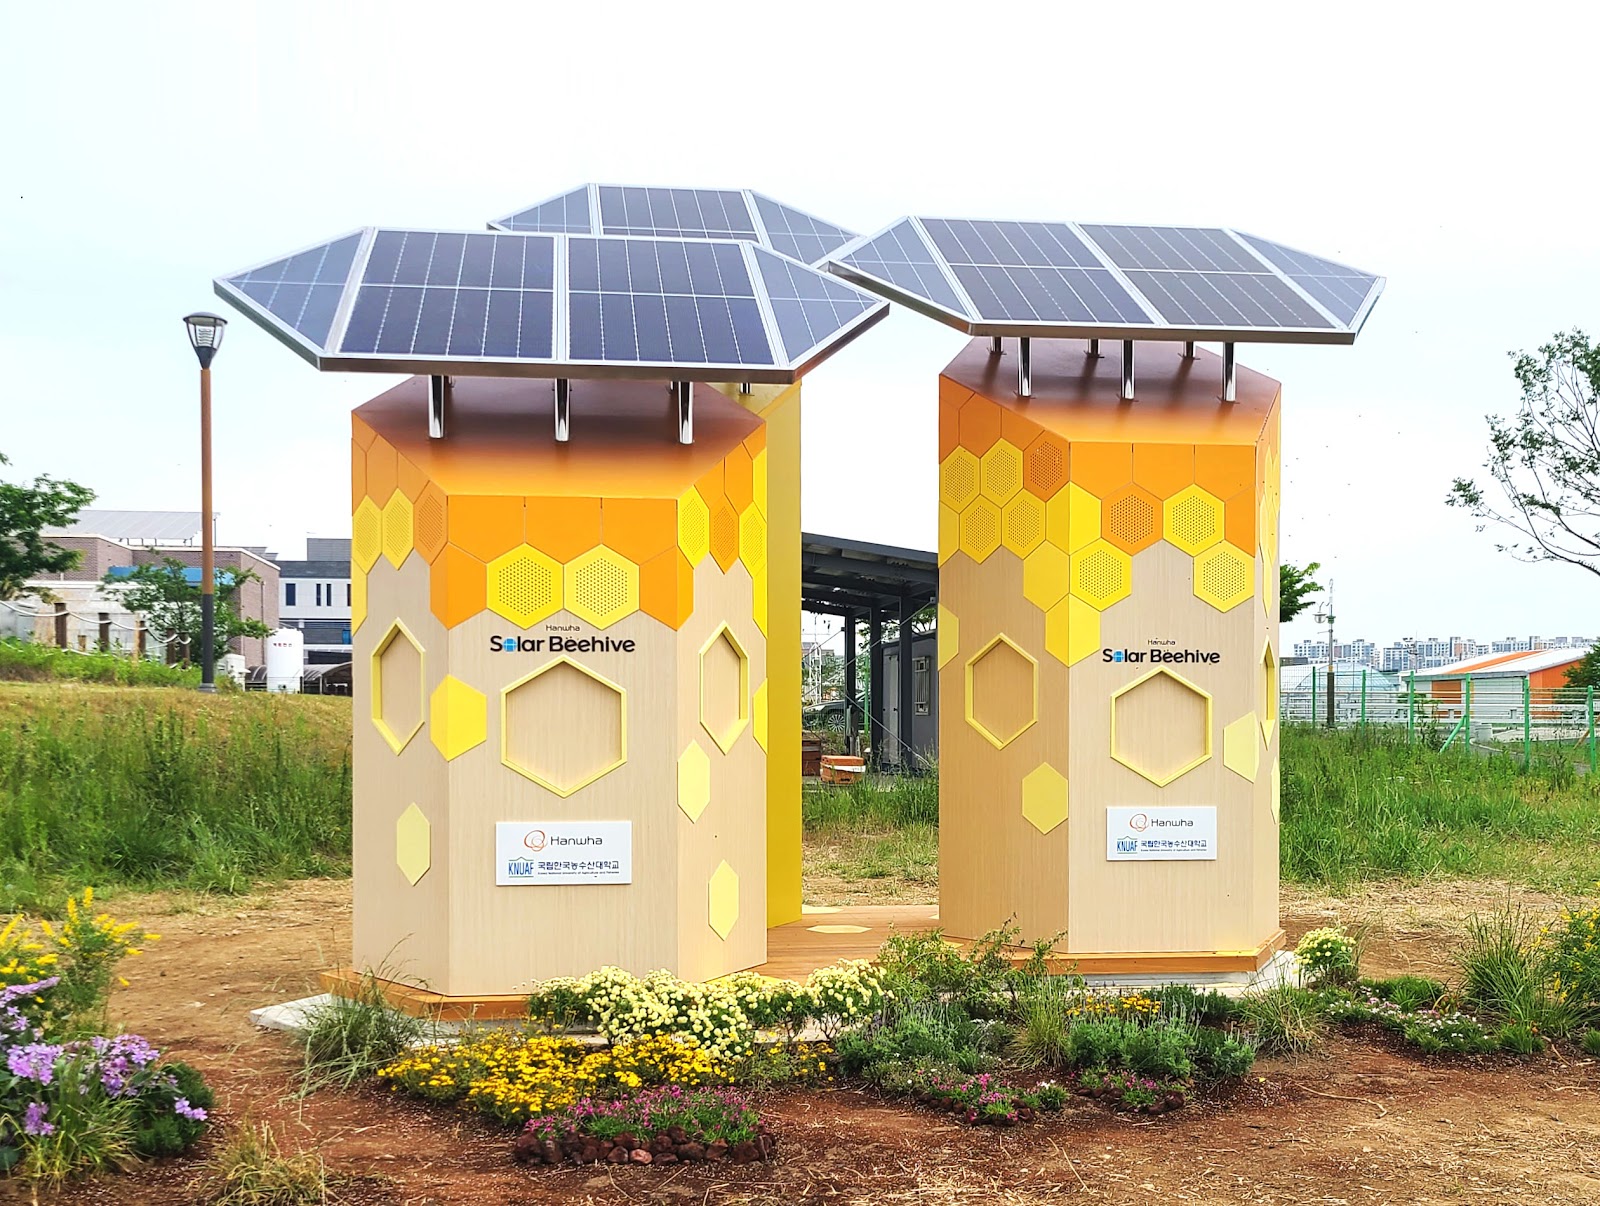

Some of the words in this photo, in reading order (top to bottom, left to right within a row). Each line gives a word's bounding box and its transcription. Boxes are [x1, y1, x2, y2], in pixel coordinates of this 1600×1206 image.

[490, 635, 545, 652] Solar
[549, 635, 635, 652] Beehive
[1102, 648, 1147, 663] Solar
[1150, 648, 1219, 663] Beehive
[1151, 819, 1194, 827] Hanwha
[550, 836, 603, 846] Hanwha
[1116, 840, 1138, 852] KNUAF
[1140, 839, 1207, 848] 국립한국농수산대학교
[508, 862, 534, 875] KNUAF
[538, 861, 619, 870] 국립한국농수산대학교
